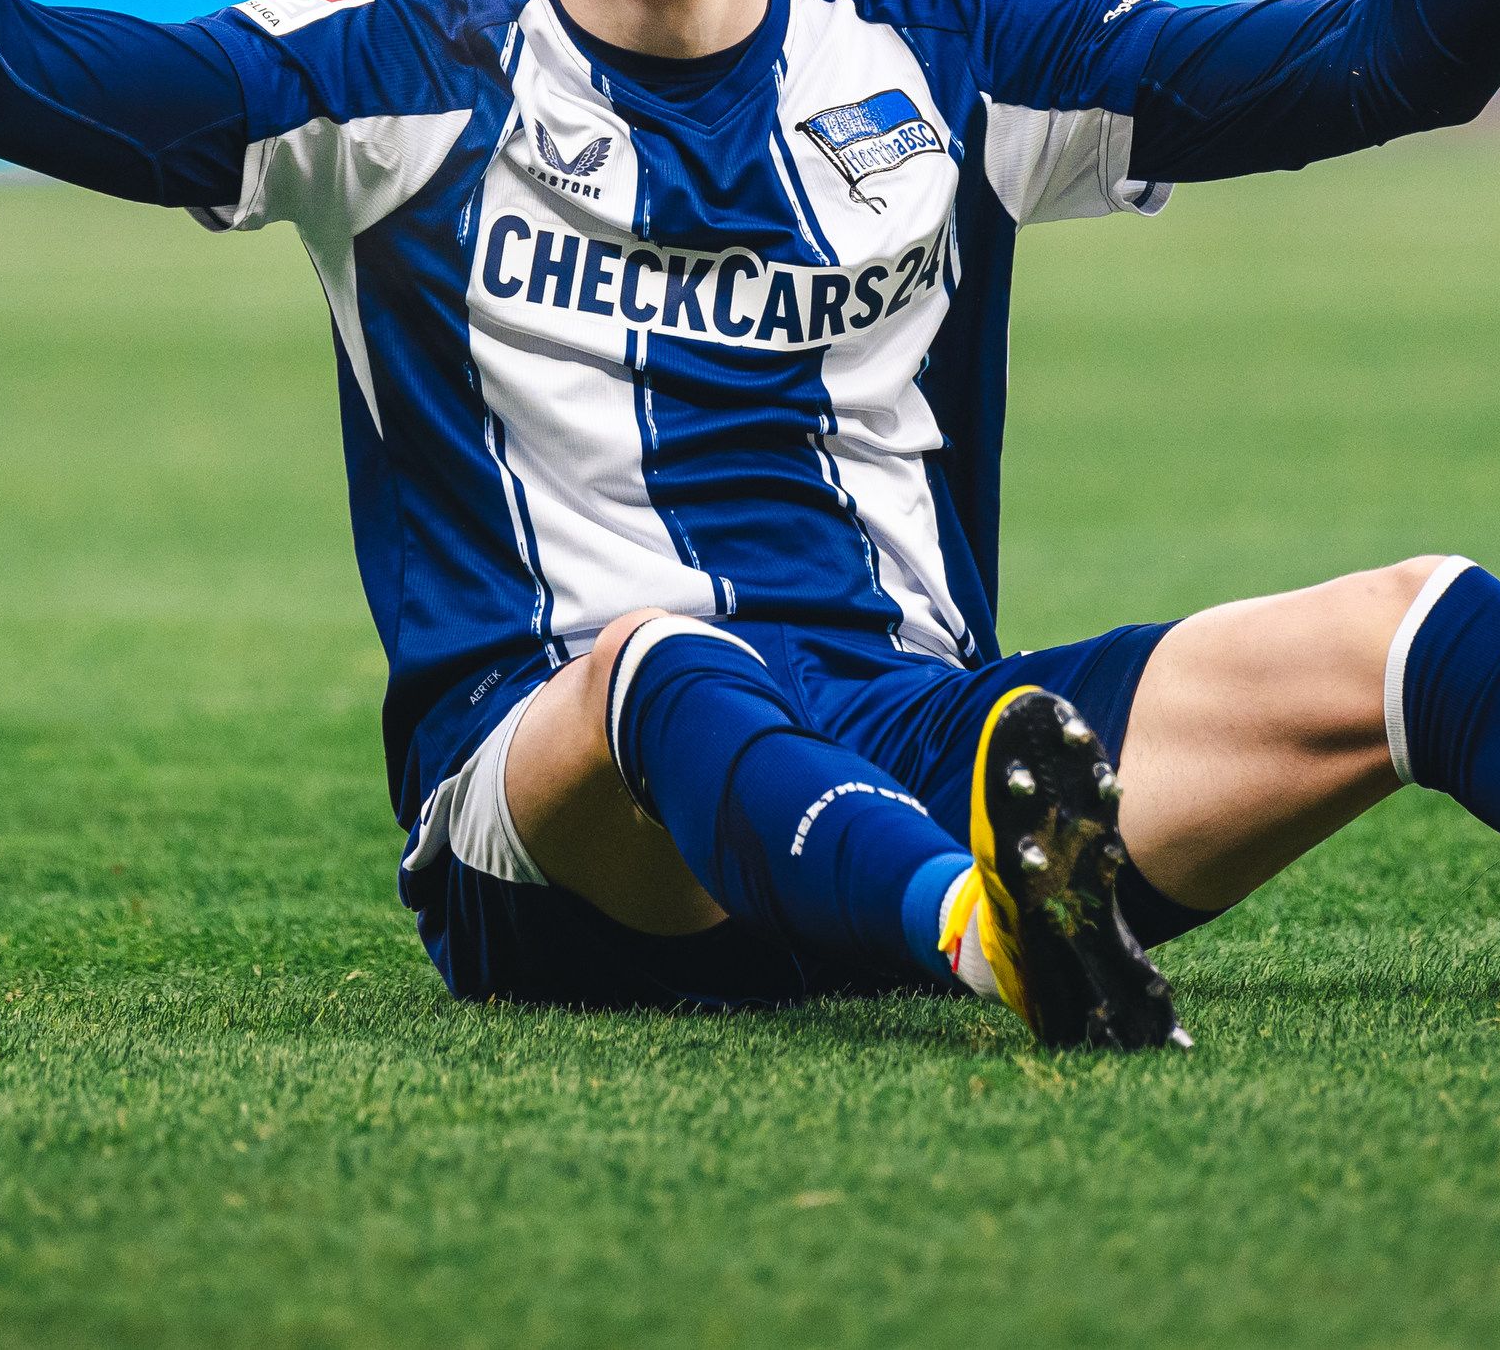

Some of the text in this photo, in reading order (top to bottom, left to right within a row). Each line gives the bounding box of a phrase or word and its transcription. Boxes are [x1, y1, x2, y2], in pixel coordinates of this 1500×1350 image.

[527, 167, 601, 199] CASTORE
[482, 214, 946, 343] CHECKCARS24
[469, 669, 502, 705] AERTEK
